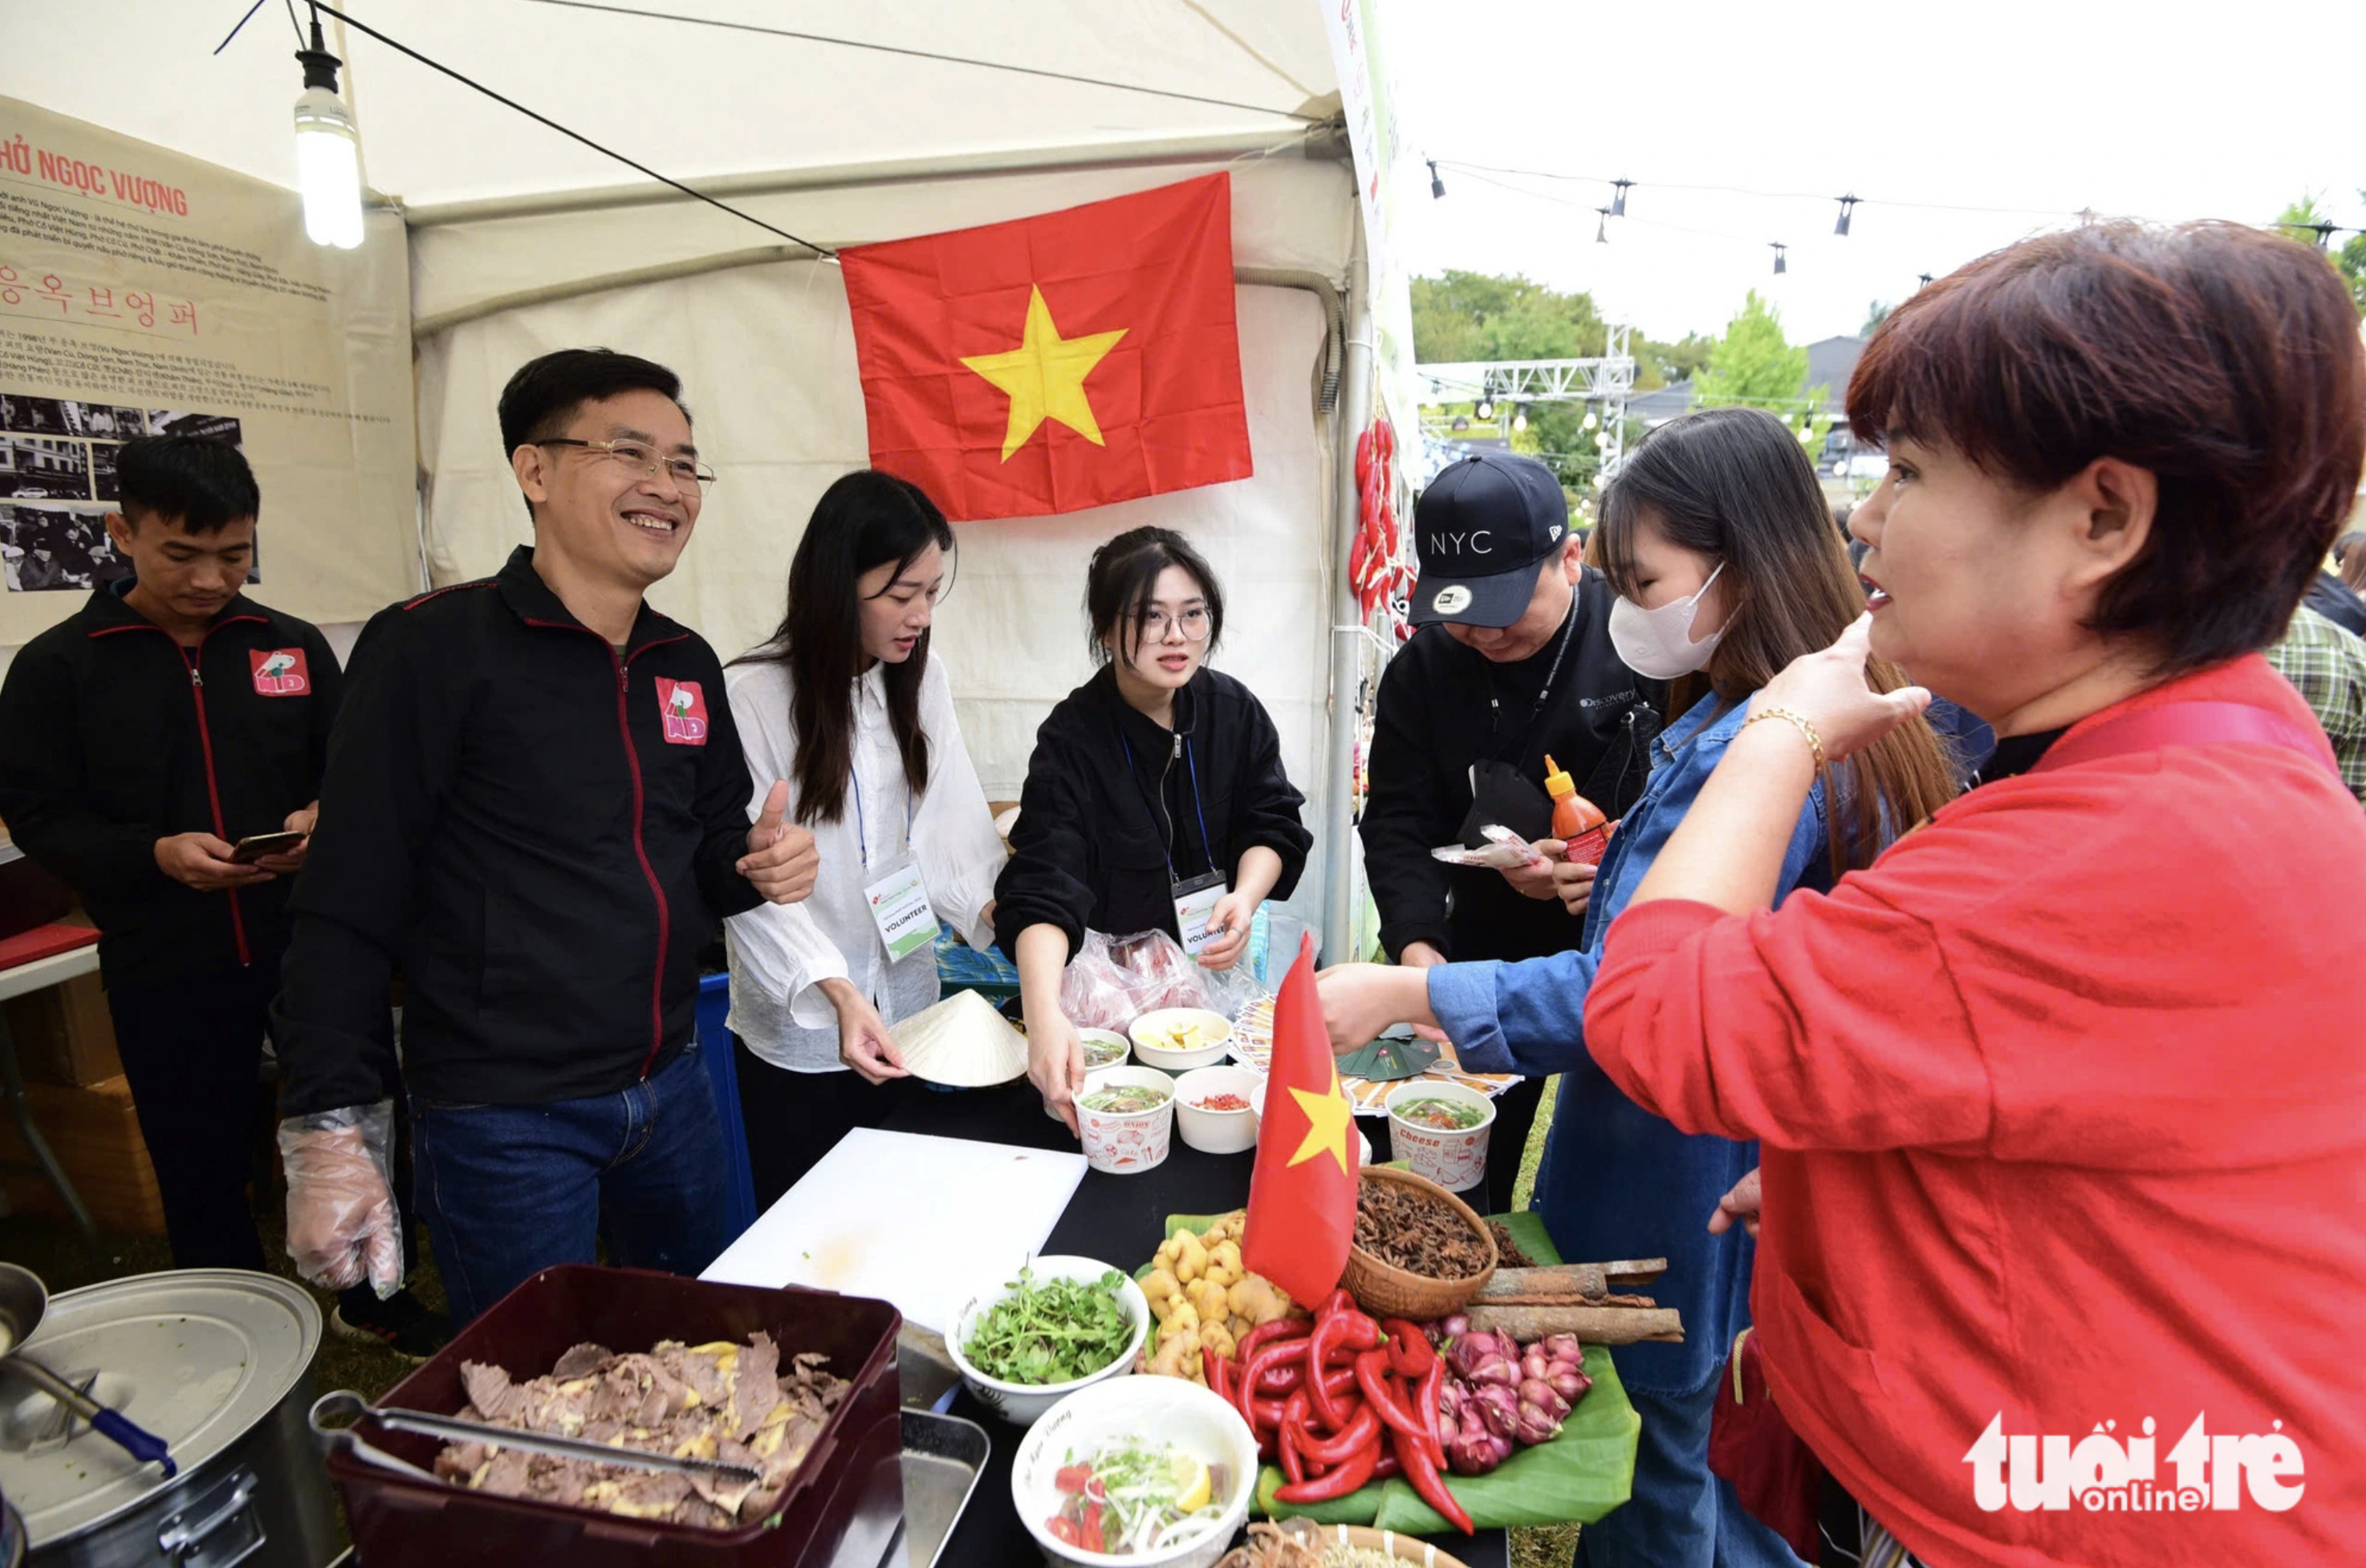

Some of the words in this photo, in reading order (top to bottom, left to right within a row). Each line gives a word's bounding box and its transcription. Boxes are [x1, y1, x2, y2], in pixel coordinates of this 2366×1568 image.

[0, 134, 31, 174] HỞ
[38, 149, 106, 196] NGỌC
[110, 169, 188, 217] VƯỢNG
[169, 300, 197, 336] 퍼
[1431, 530, 1492, 555] NYC
[884, 904, 928, 932] VOLUNTEER
[1400, 1127, 1441, 1148] Cheese
